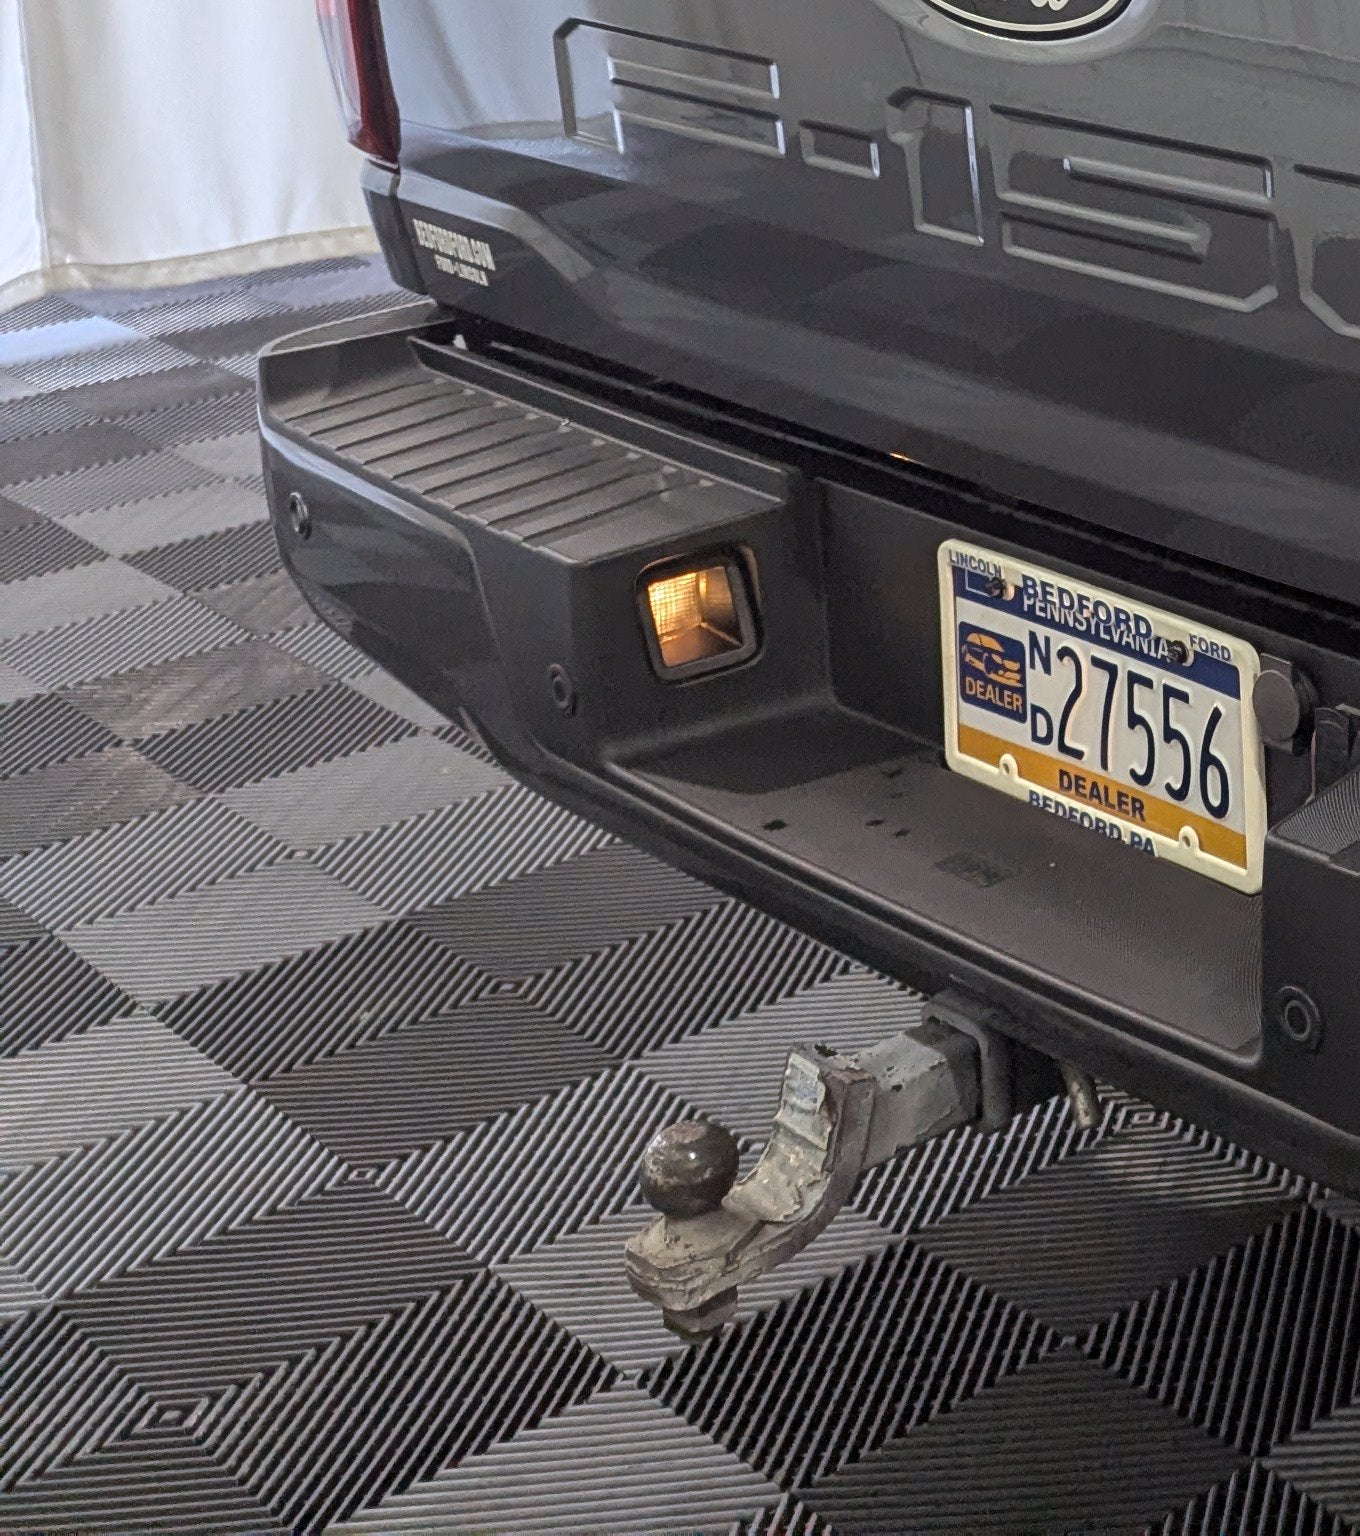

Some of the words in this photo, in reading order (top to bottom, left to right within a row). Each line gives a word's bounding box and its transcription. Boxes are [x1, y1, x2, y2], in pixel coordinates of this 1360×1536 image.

[949, 550, 1003, 579] LINCOLN
[1022, 573, 1153, 640] BEDFORD
[1189, 633, 1232, 662] FORD
[964, 678, 1024, 714] DEALER
[1057, 645, 1230, 819] 27556
[1058, 768, 1146, 823] DEALER
[1130, 830, 1155, 857] PA
